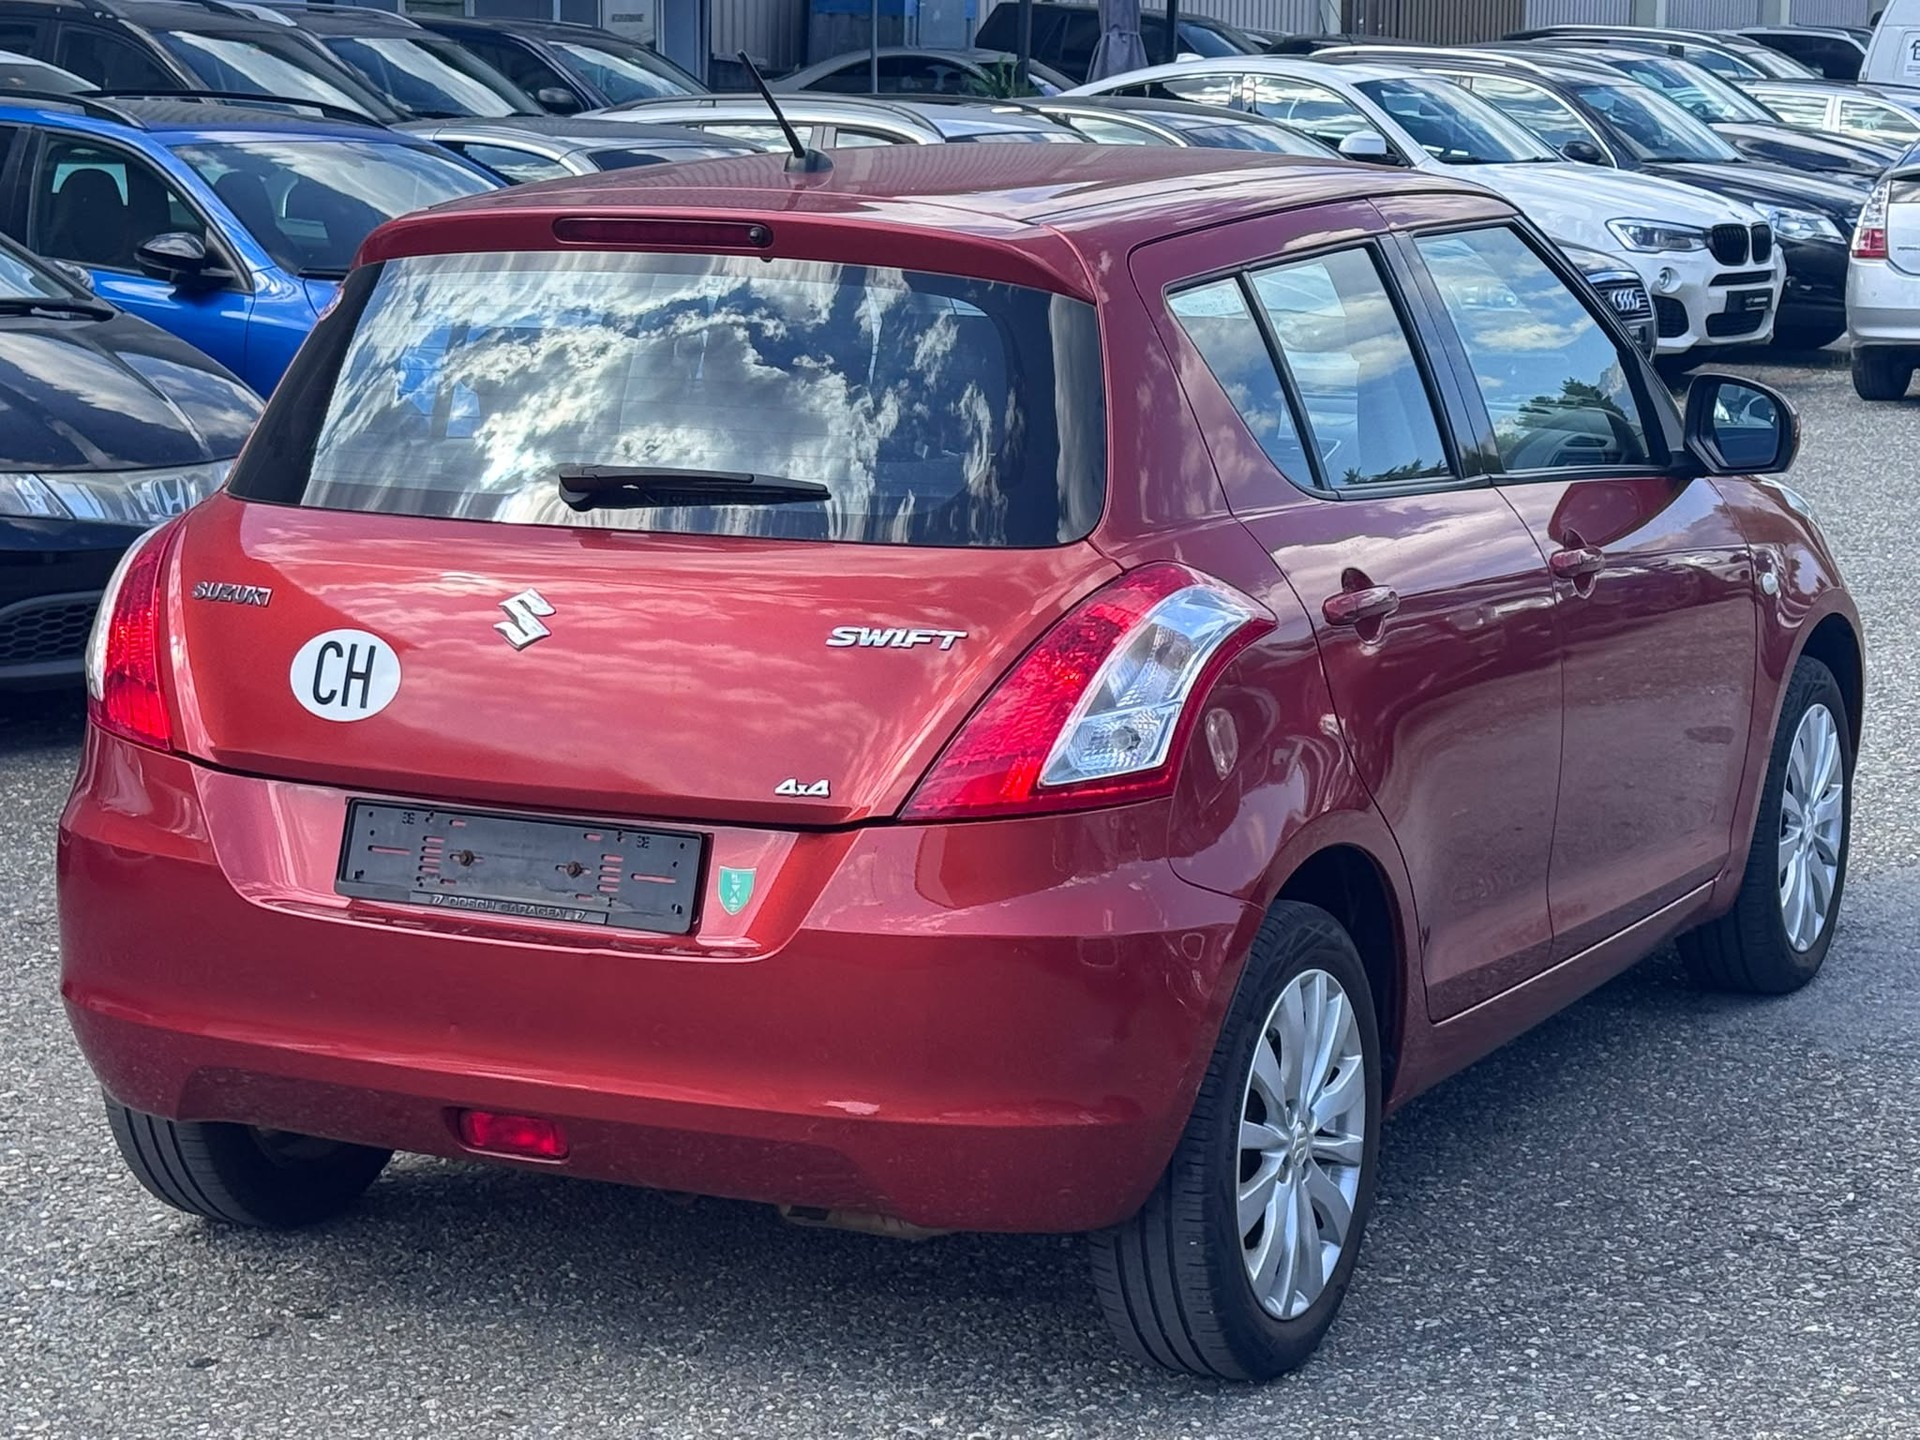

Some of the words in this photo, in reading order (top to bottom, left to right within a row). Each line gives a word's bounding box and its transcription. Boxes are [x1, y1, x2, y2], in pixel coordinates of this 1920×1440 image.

[192, 580, 273, 607] SUZUKI
[825, 625, 968, 651] SWIFT
[312, 640, 377, 709] CH
[774, 777, 831, 798] 4x4
